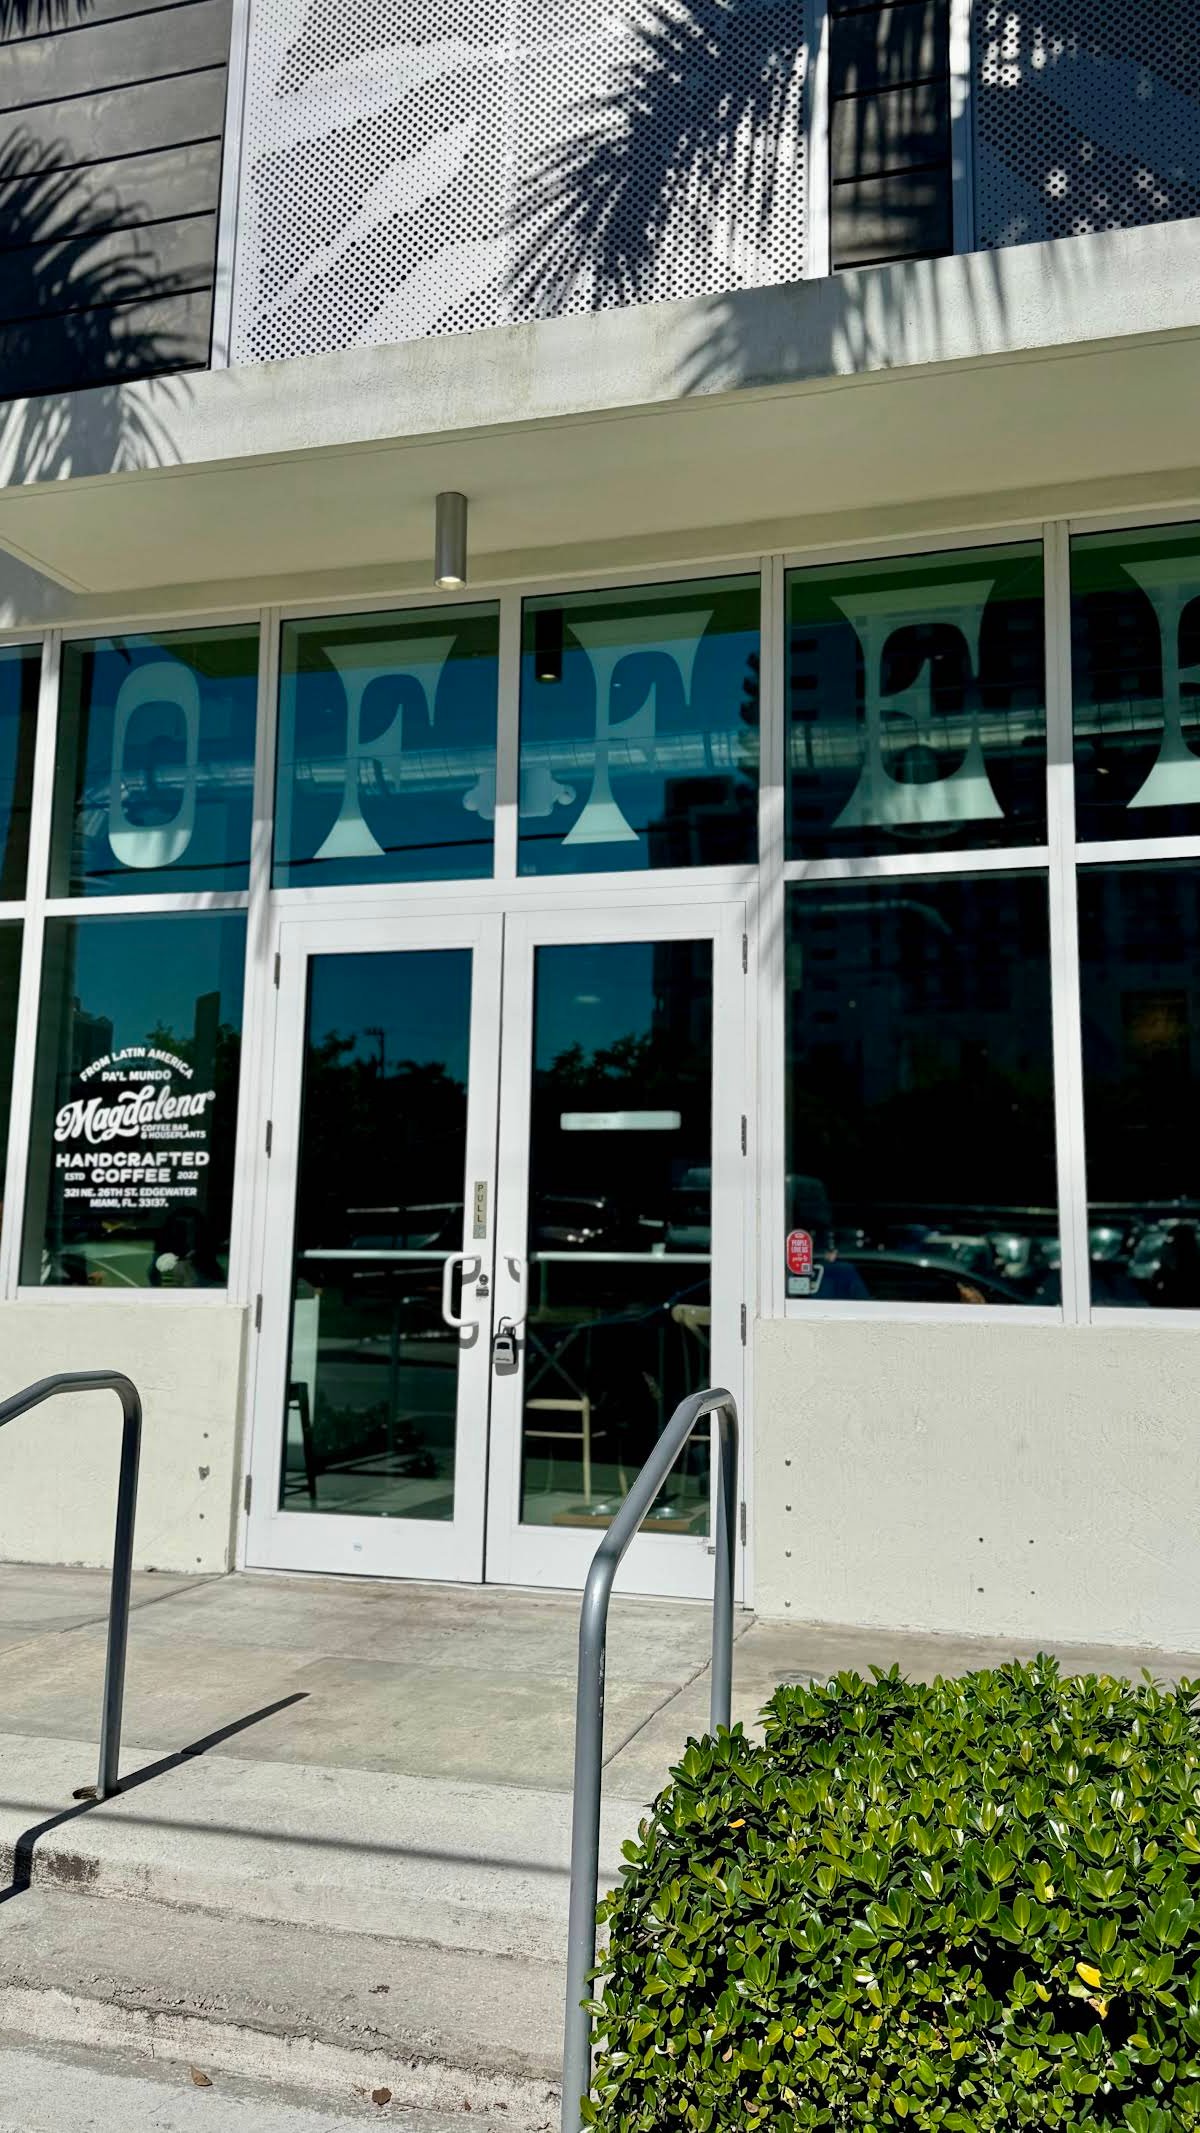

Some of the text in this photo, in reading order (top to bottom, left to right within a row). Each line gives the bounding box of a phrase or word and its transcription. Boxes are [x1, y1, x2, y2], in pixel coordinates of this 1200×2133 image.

[79, 1048, 194, 1082] FROM LATIN AMERICA
[102, 1070, 172, 1081] PA'L MUNDO
[141, 1124, 171, 1132] COFFEE
[148, 1131, 206, 1139] HOUSEPLANTS
[56, 1152, 210, 1167] HANDCRAFTED
[64, 1168, 199, 1183] ESTD COFFEE 2022
[64, 1188, 197, 1197] 321 NE. 26TH ST. EDGEWATER
[90, 1199, 121, 1208] MIAMI,
